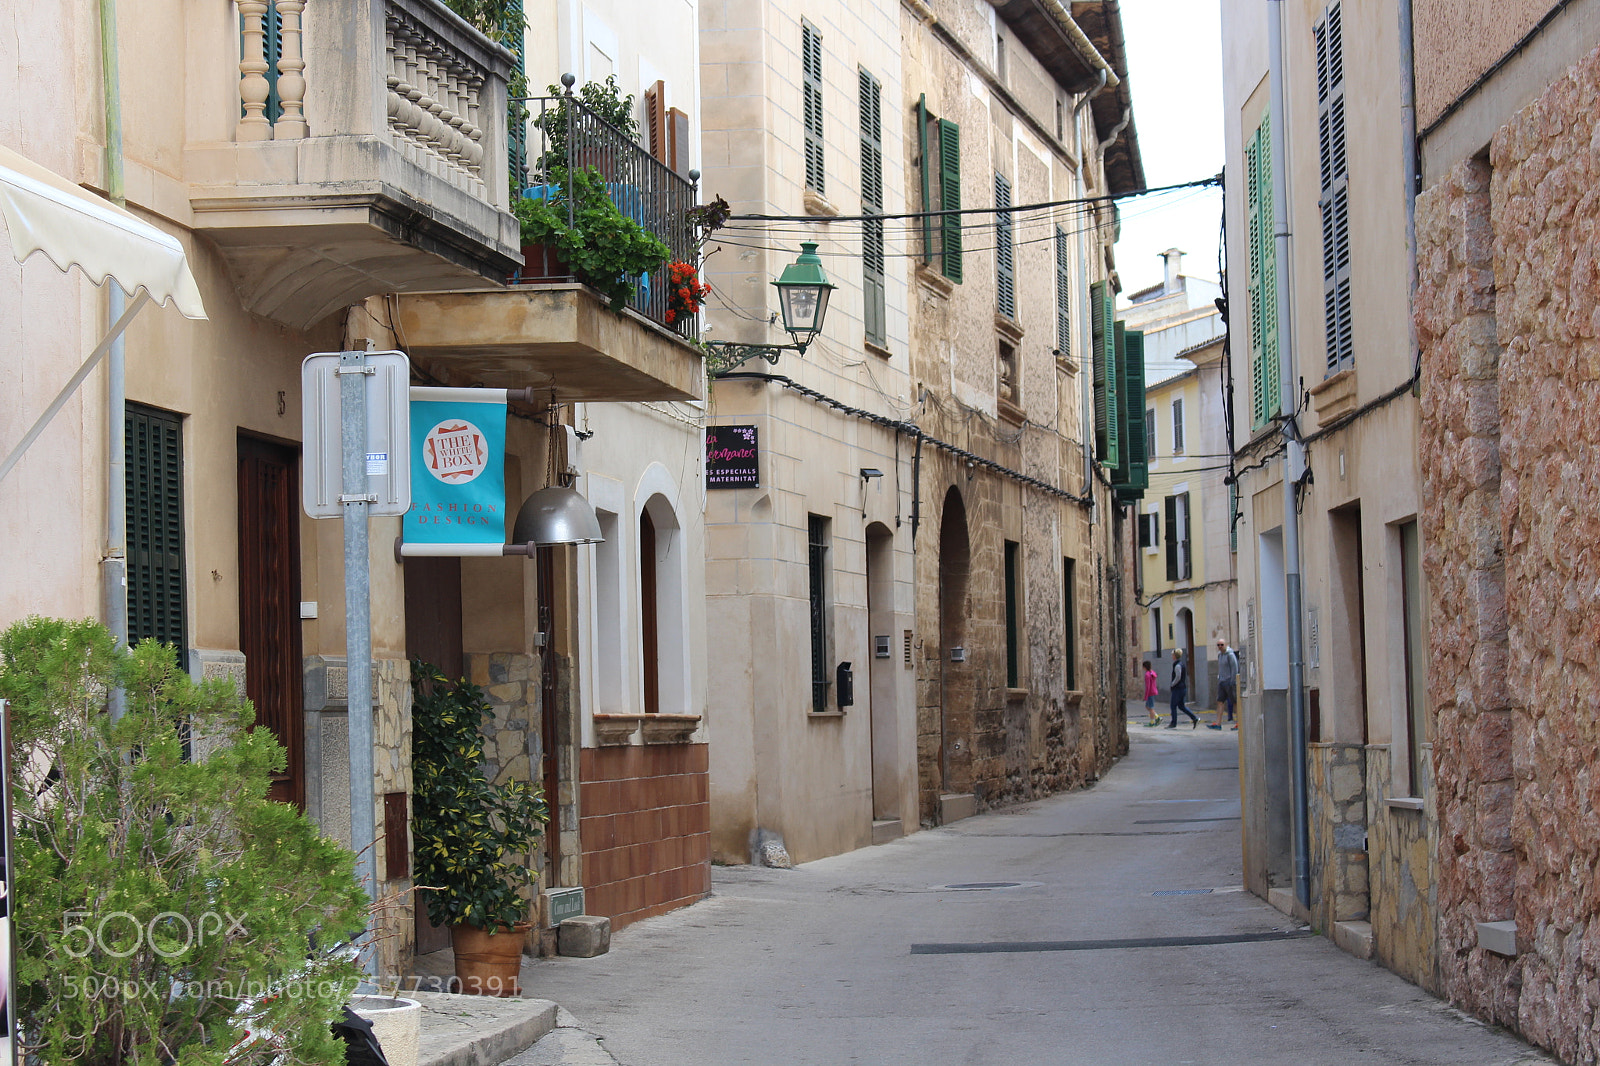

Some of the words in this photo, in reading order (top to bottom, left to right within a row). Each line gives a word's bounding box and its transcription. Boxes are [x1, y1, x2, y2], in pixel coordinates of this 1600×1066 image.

[437, 434, 471, 449] THE
[440, 446, 473, 457] WHITE
[706, 447, 756, 461] ermanes
[441, 454, 473, 468] BOX
[411, 502, 496, 512] FASHION
[418, 515, 489, 525] DESIGN
